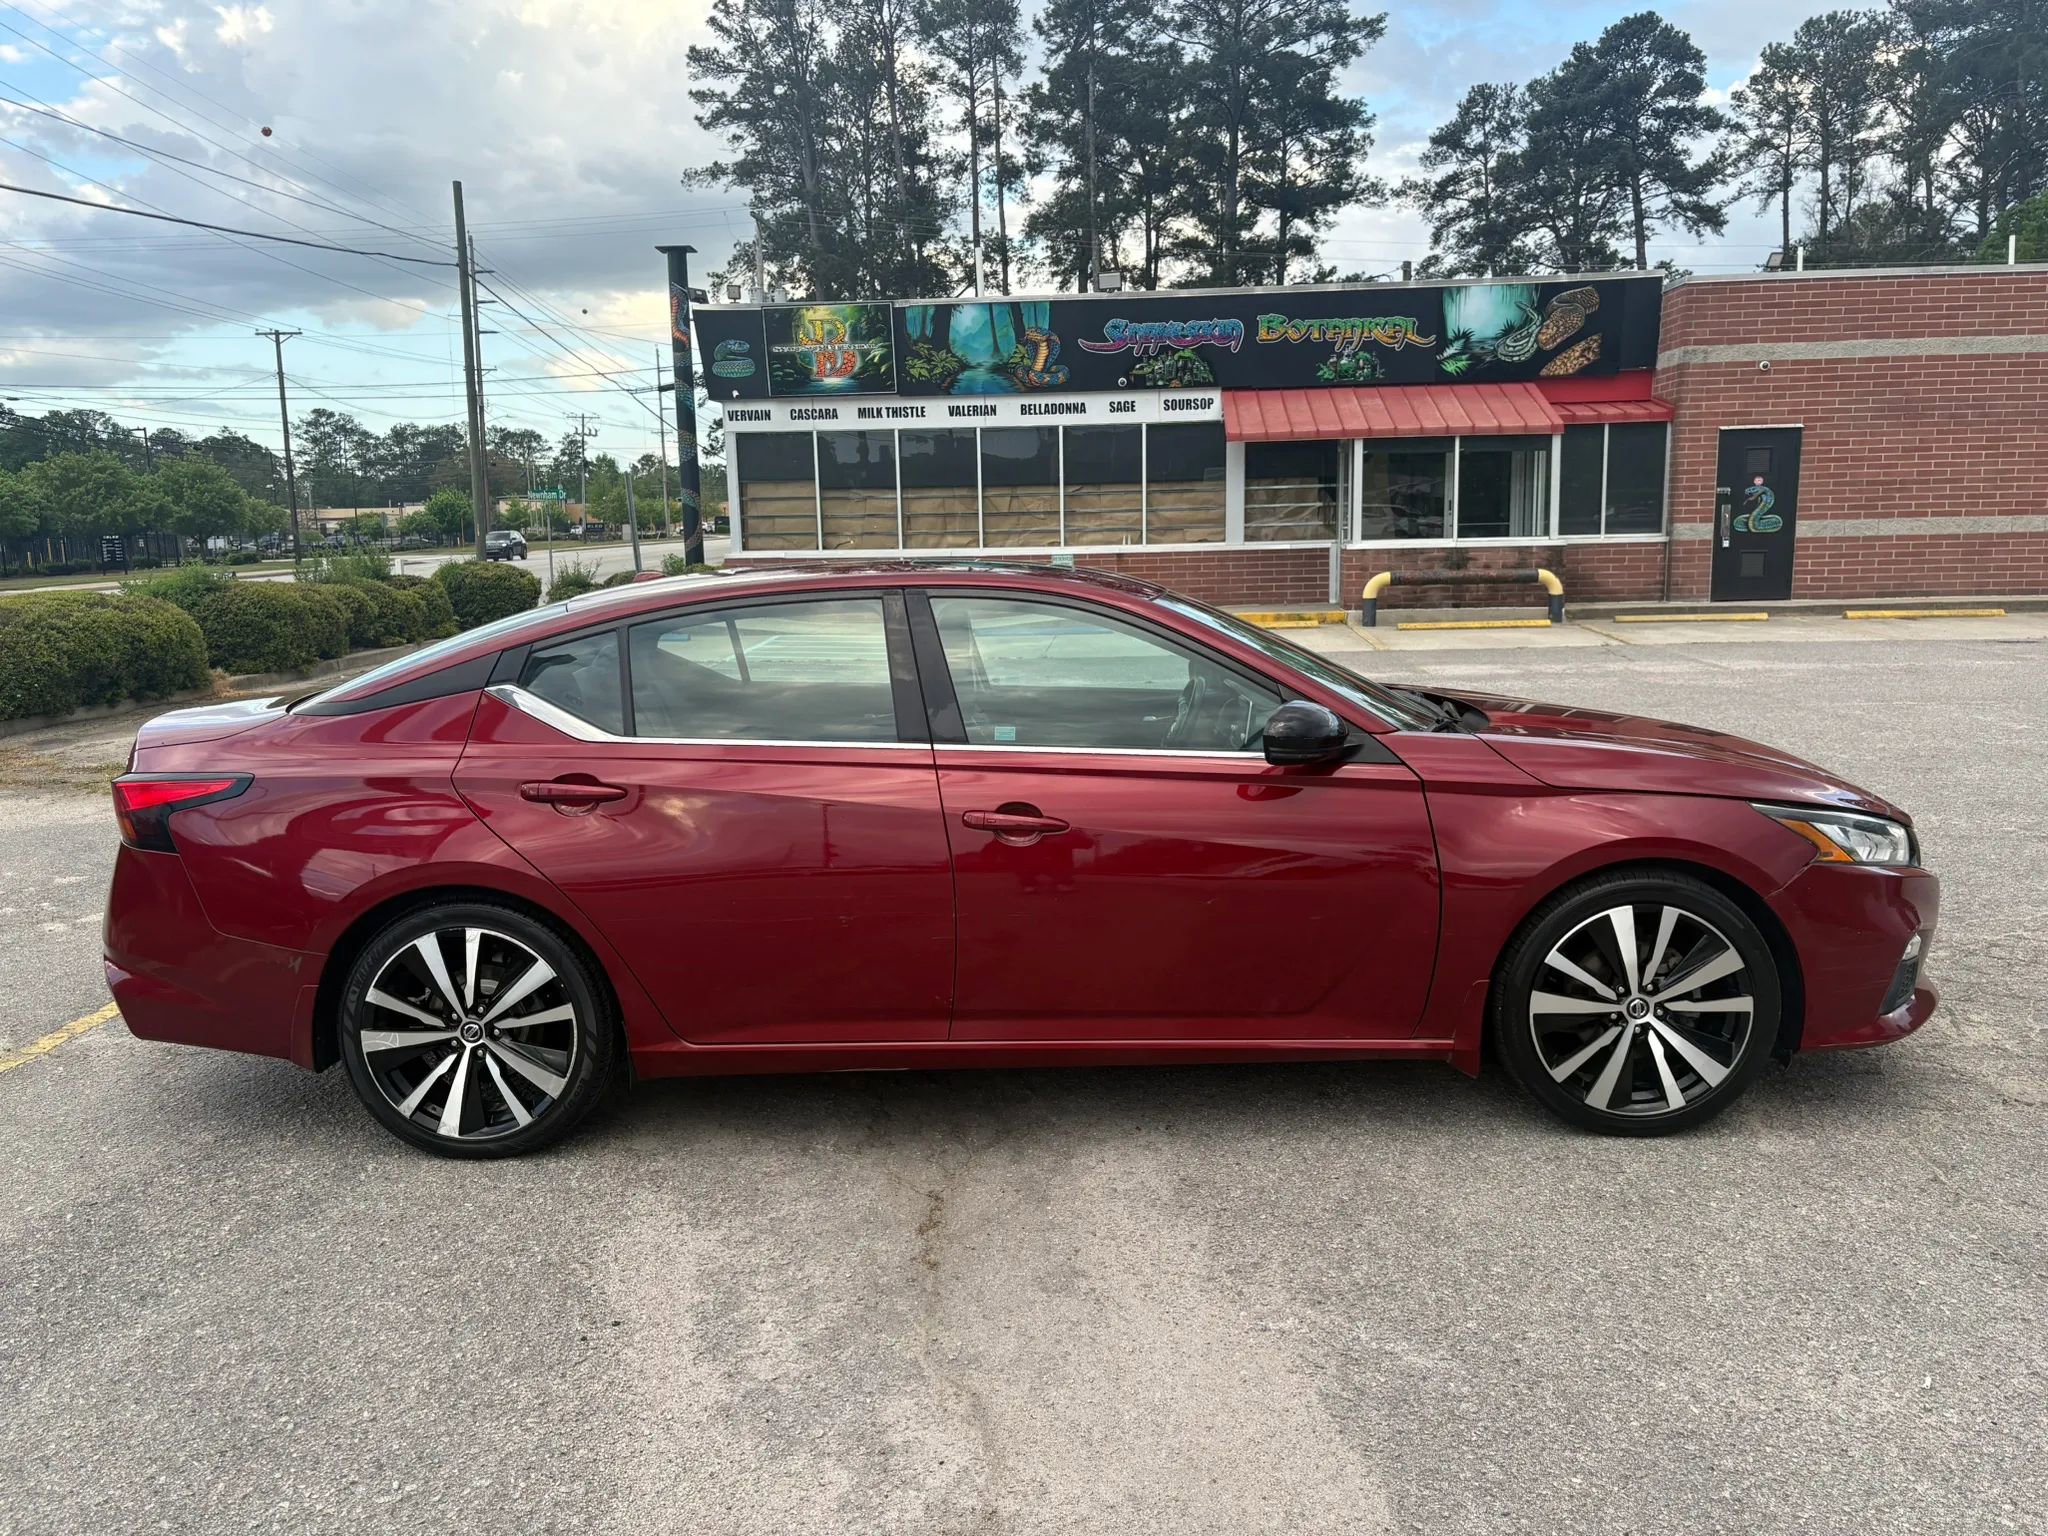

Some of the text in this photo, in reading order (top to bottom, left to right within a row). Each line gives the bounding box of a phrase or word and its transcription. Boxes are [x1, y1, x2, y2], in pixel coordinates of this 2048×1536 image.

[947, 404, 997, 417] VALERIAN
[1020, 402, 1087, 415] BELLADONNA
[1109, 400, 1136, 413] SAGE
[1163, 397, 1214, 411] SOURSOP
[727, 409, 771, 421] VERVAIN
[790, 408, 838, 420] CASCARA
[857, 406, 926, 419] MILK THISTLE
[527, 490, 566, 499] Newnham Dr
